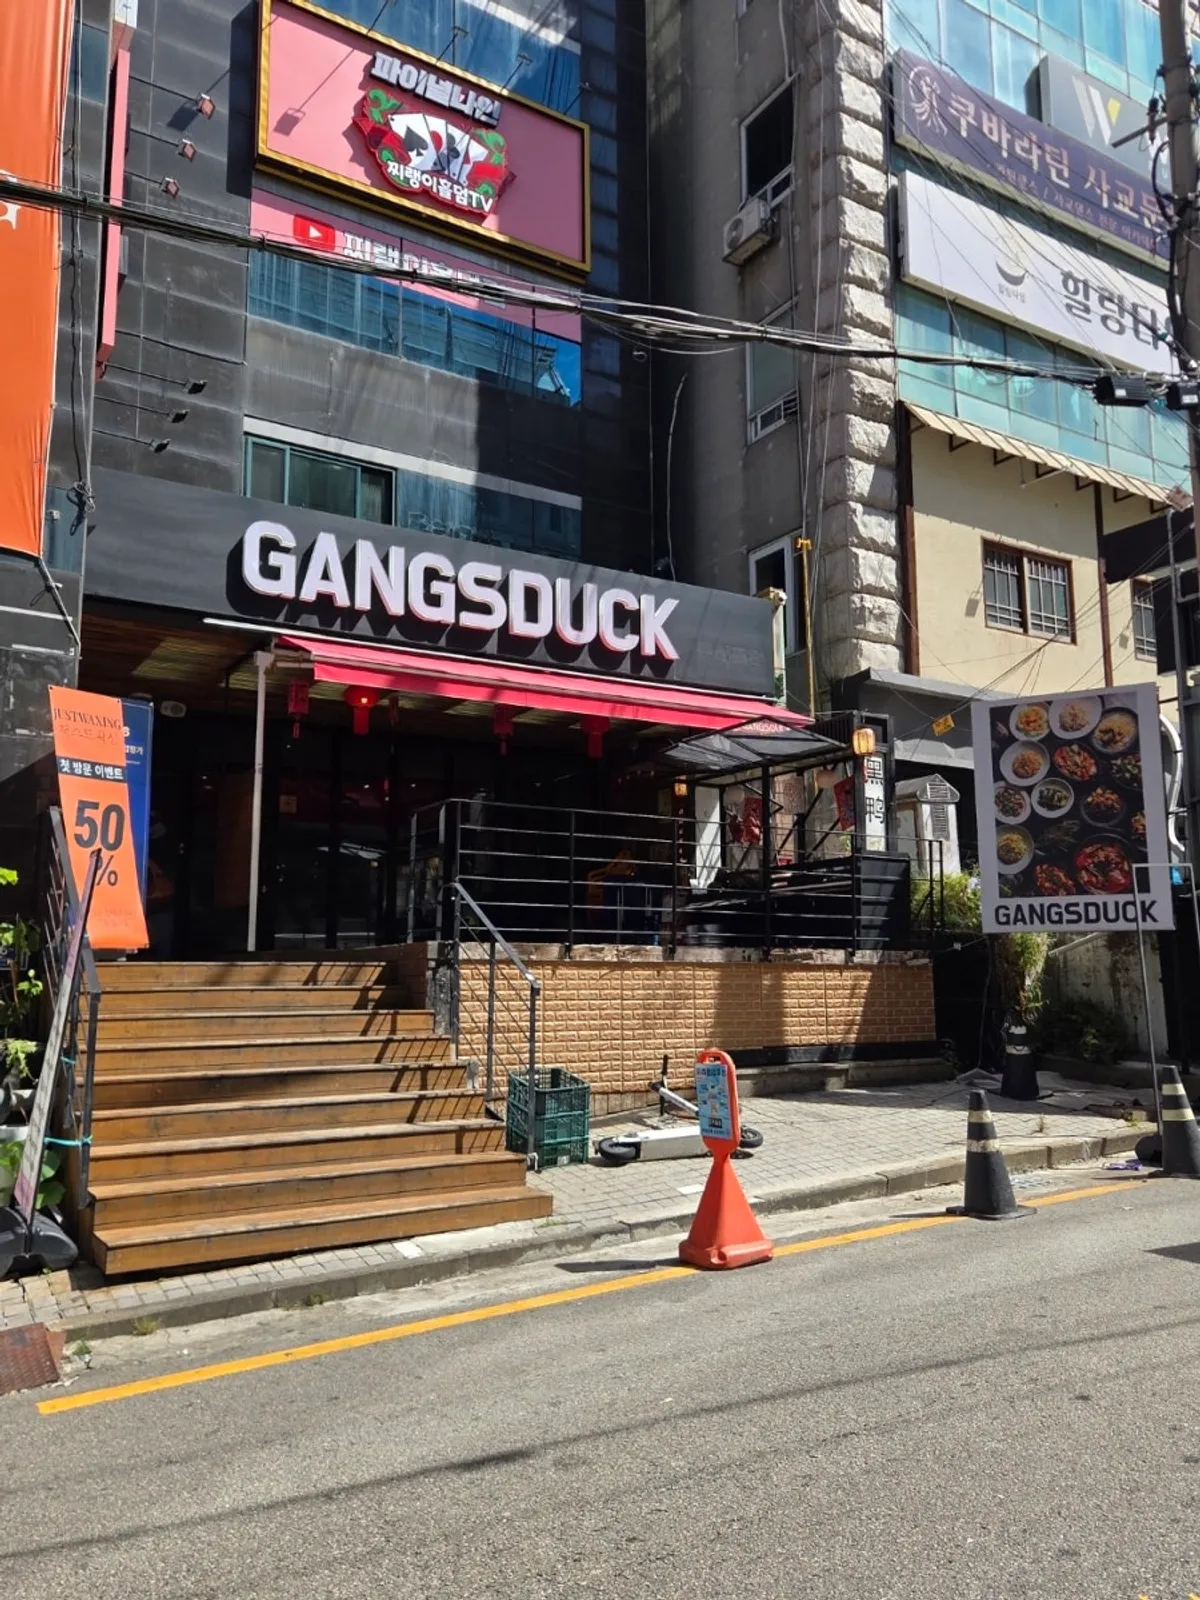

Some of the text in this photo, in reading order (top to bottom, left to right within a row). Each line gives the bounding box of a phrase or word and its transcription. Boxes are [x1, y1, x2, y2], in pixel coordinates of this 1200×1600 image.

[946, 92, 1070, 189] 쿠바라틴
[242, 520, 680, 660] GANGSDUCK
[60, 758, 124, 780] 첫 방문 이벤트
[74, 800, 125, 850] 50
[994, 901, 1159, 926] GANGSDUCK
